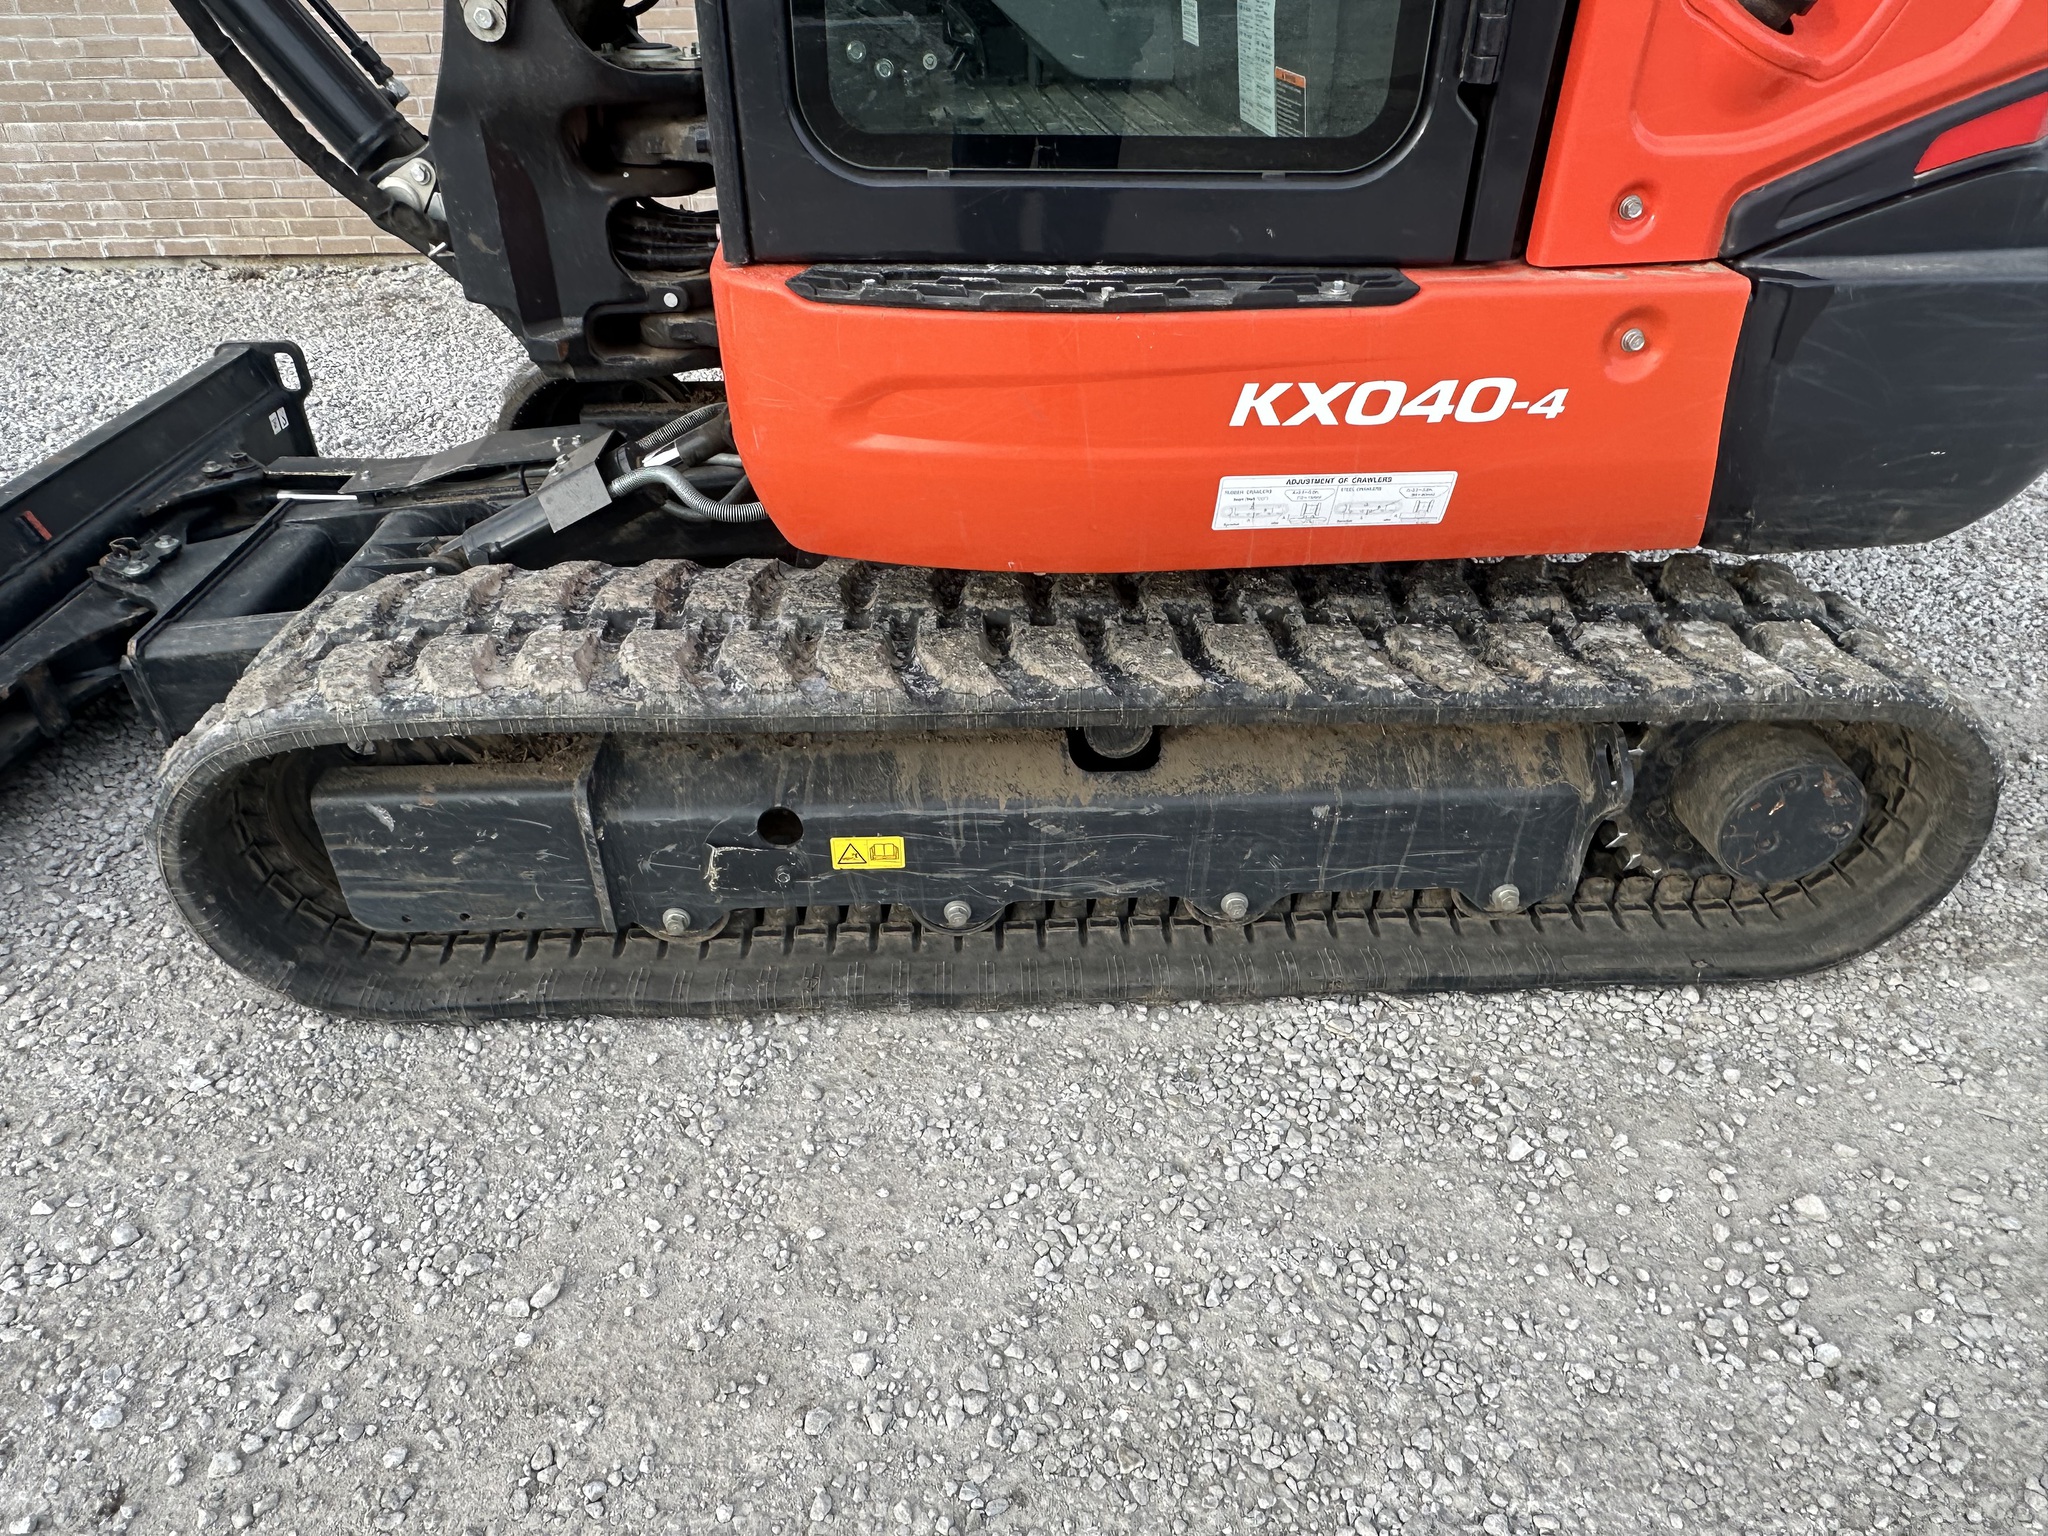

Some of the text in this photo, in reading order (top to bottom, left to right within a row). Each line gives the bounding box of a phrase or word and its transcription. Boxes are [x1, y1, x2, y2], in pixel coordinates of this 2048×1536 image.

[1229, 377, 1570, 427] KX040-4
[1286, 477, 1335, 485] ADJUSTMENT
[1352, 476, 1393, 484] CRAWLERS
